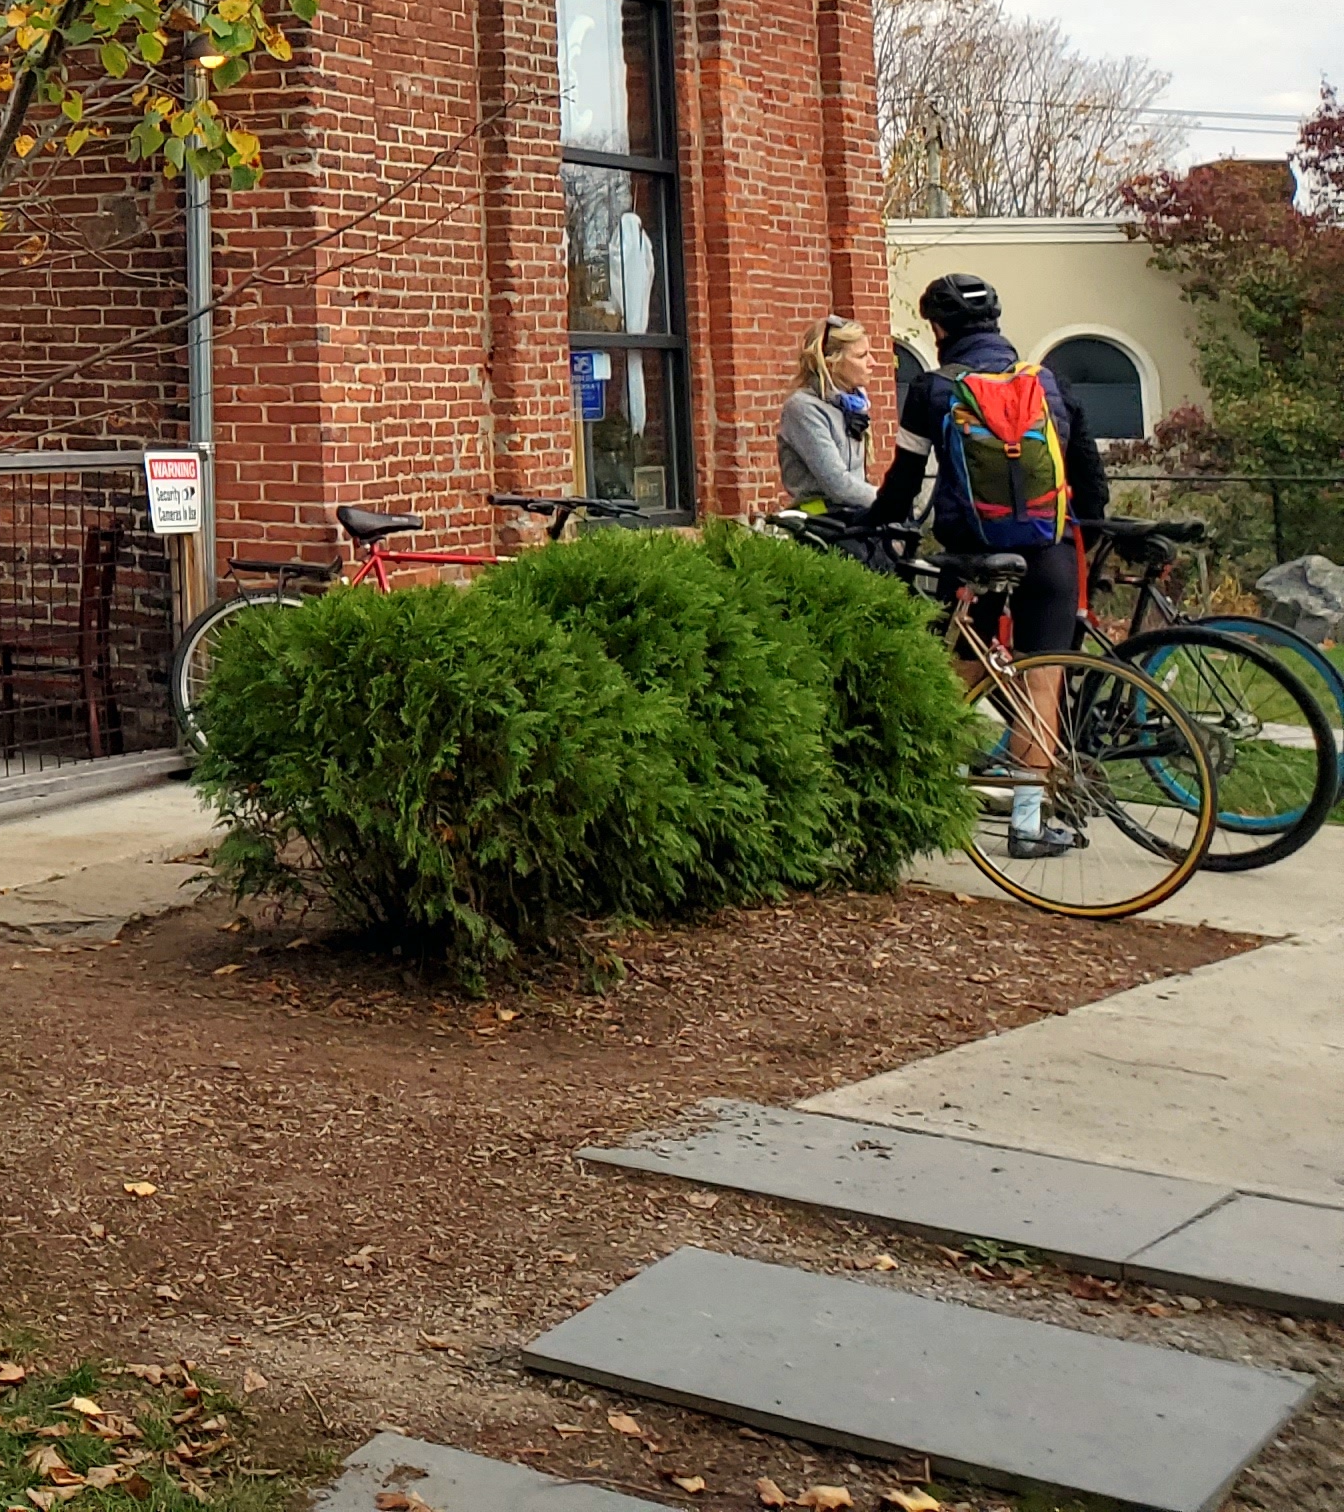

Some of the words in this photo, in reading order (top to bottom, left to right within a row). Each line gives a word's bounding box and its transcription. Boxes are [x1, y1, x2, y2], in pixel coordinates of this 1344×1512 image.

[151, 461, 196, 478] WARNING
[155, 485, 181, 505] Security
[158, 506, 182, 522] Cameras
